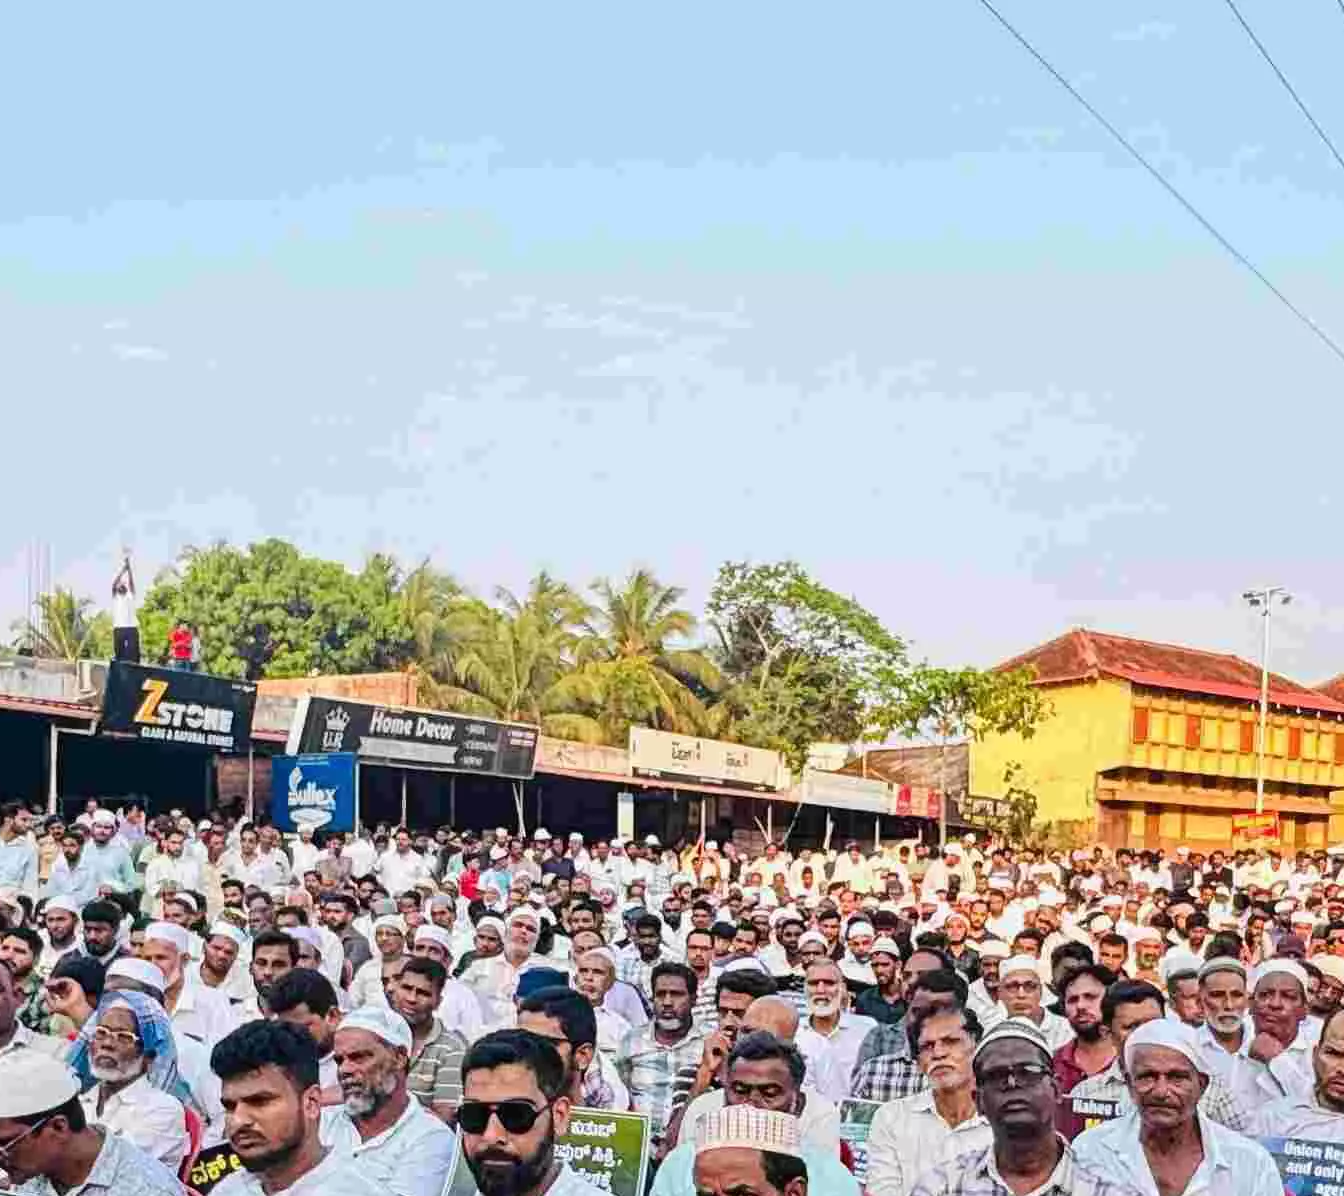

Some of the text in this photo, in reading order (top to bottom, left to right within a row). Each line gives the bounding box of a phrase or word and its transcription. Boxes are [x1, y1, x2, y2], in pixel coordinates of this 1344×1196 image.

[369, 710, 456, 741] Home Decor
[1284, 1141, 1322, 1159] Union
[1286, 1161, 1313, 1176] and
[1314, 1165, 1344, 1182] only
